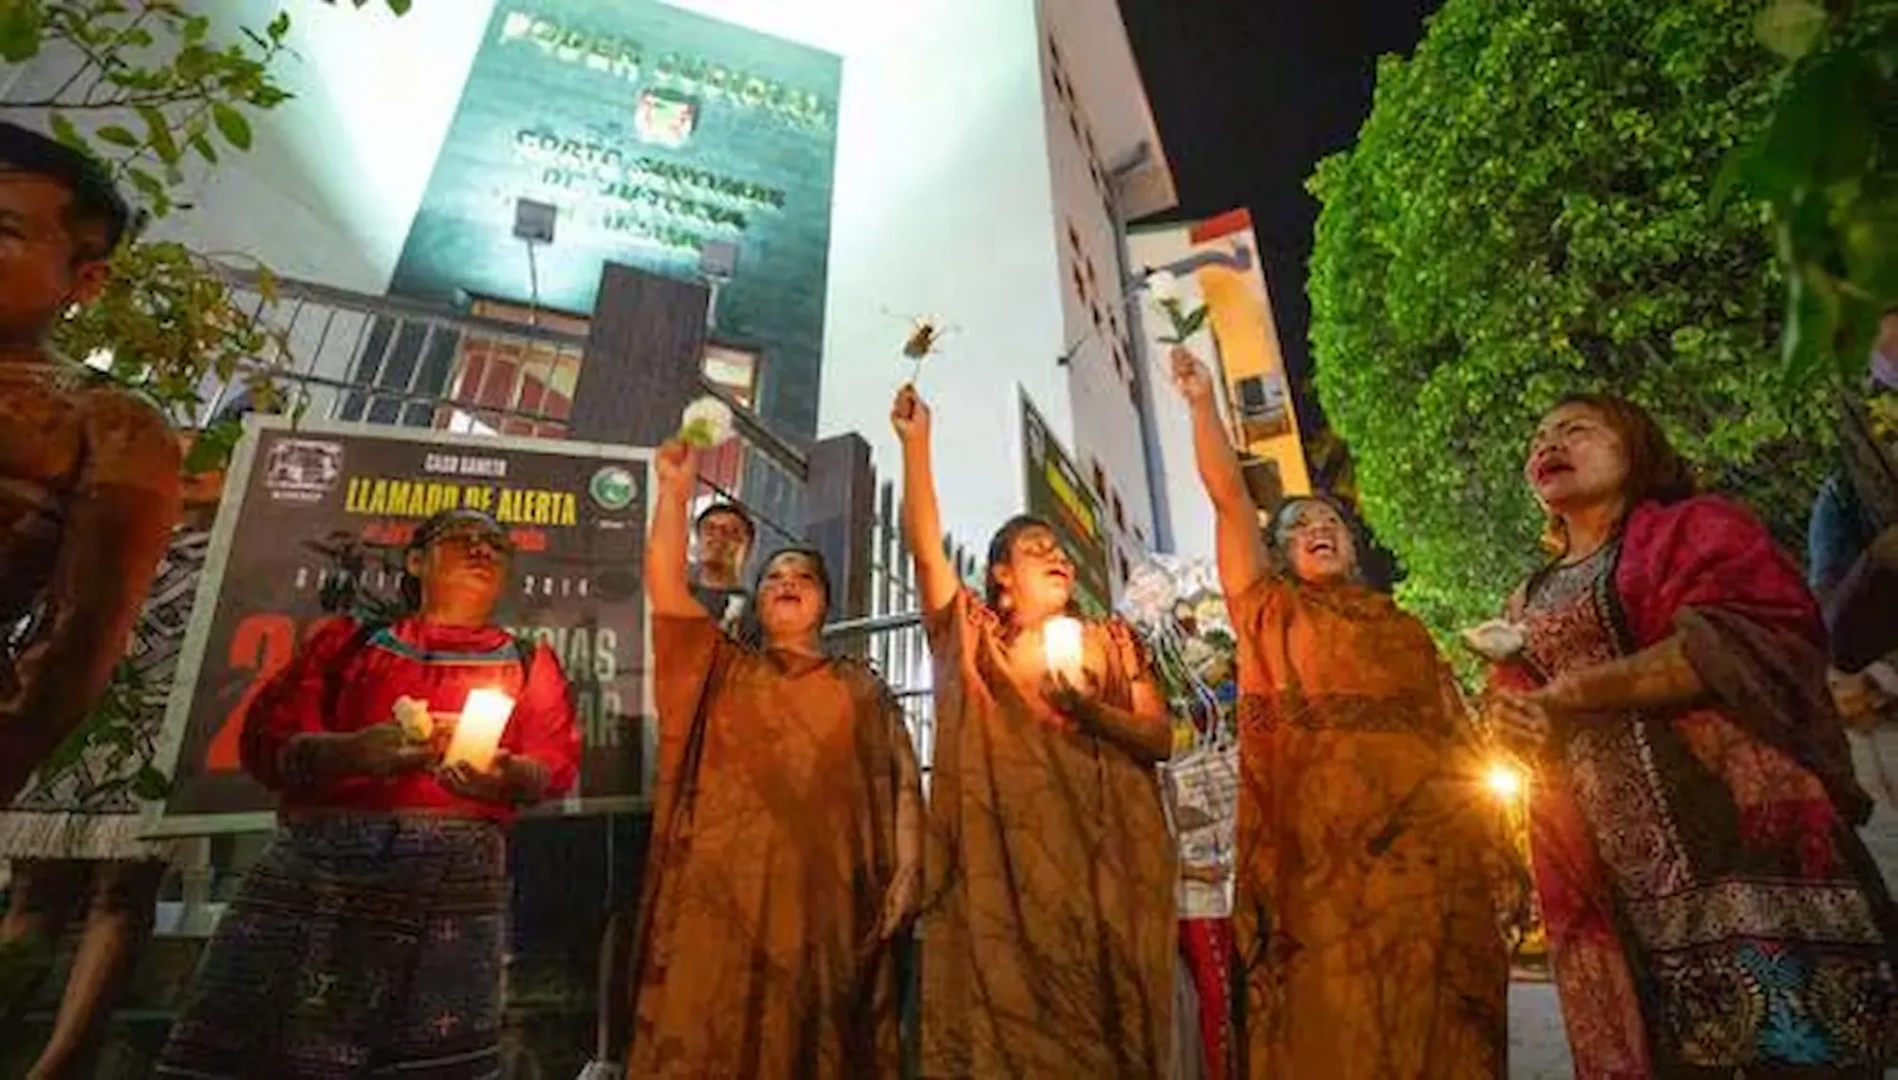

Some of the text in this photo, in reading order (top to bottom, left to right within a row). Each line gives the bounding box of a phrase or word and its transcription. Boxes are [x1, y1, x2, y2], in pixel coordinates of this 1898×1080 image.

[345, 474, 577, 526] LLAMADO DE ALERTA
